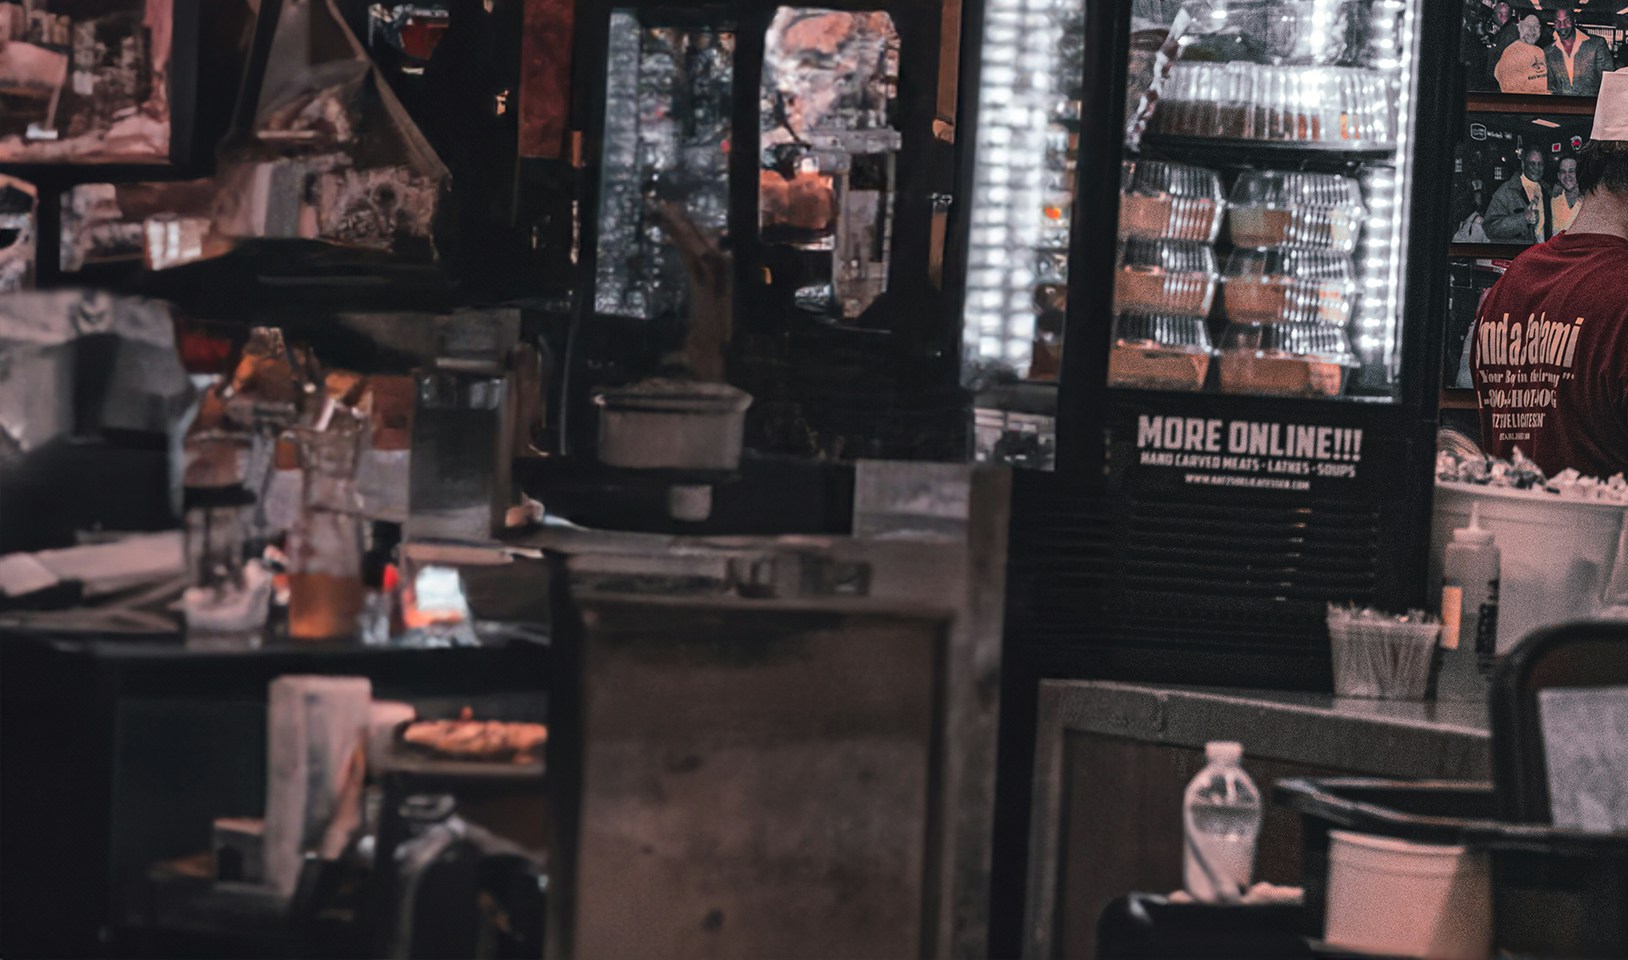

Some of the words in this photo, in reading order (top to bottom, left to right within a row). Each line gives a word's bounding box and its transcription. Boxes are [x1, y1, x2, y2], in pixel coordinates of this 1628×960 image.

[1137, 414, 1223, 452] MORE
[1228, 420, 1363, 462] ONLINE!!!
[1140, 451, 1173, 466] HAND
[1174, 453, 1221, 470] CARVED
[1222, 456, 1260, 472] MEATS
[1316, 462, 1356, 478] SOUPS
